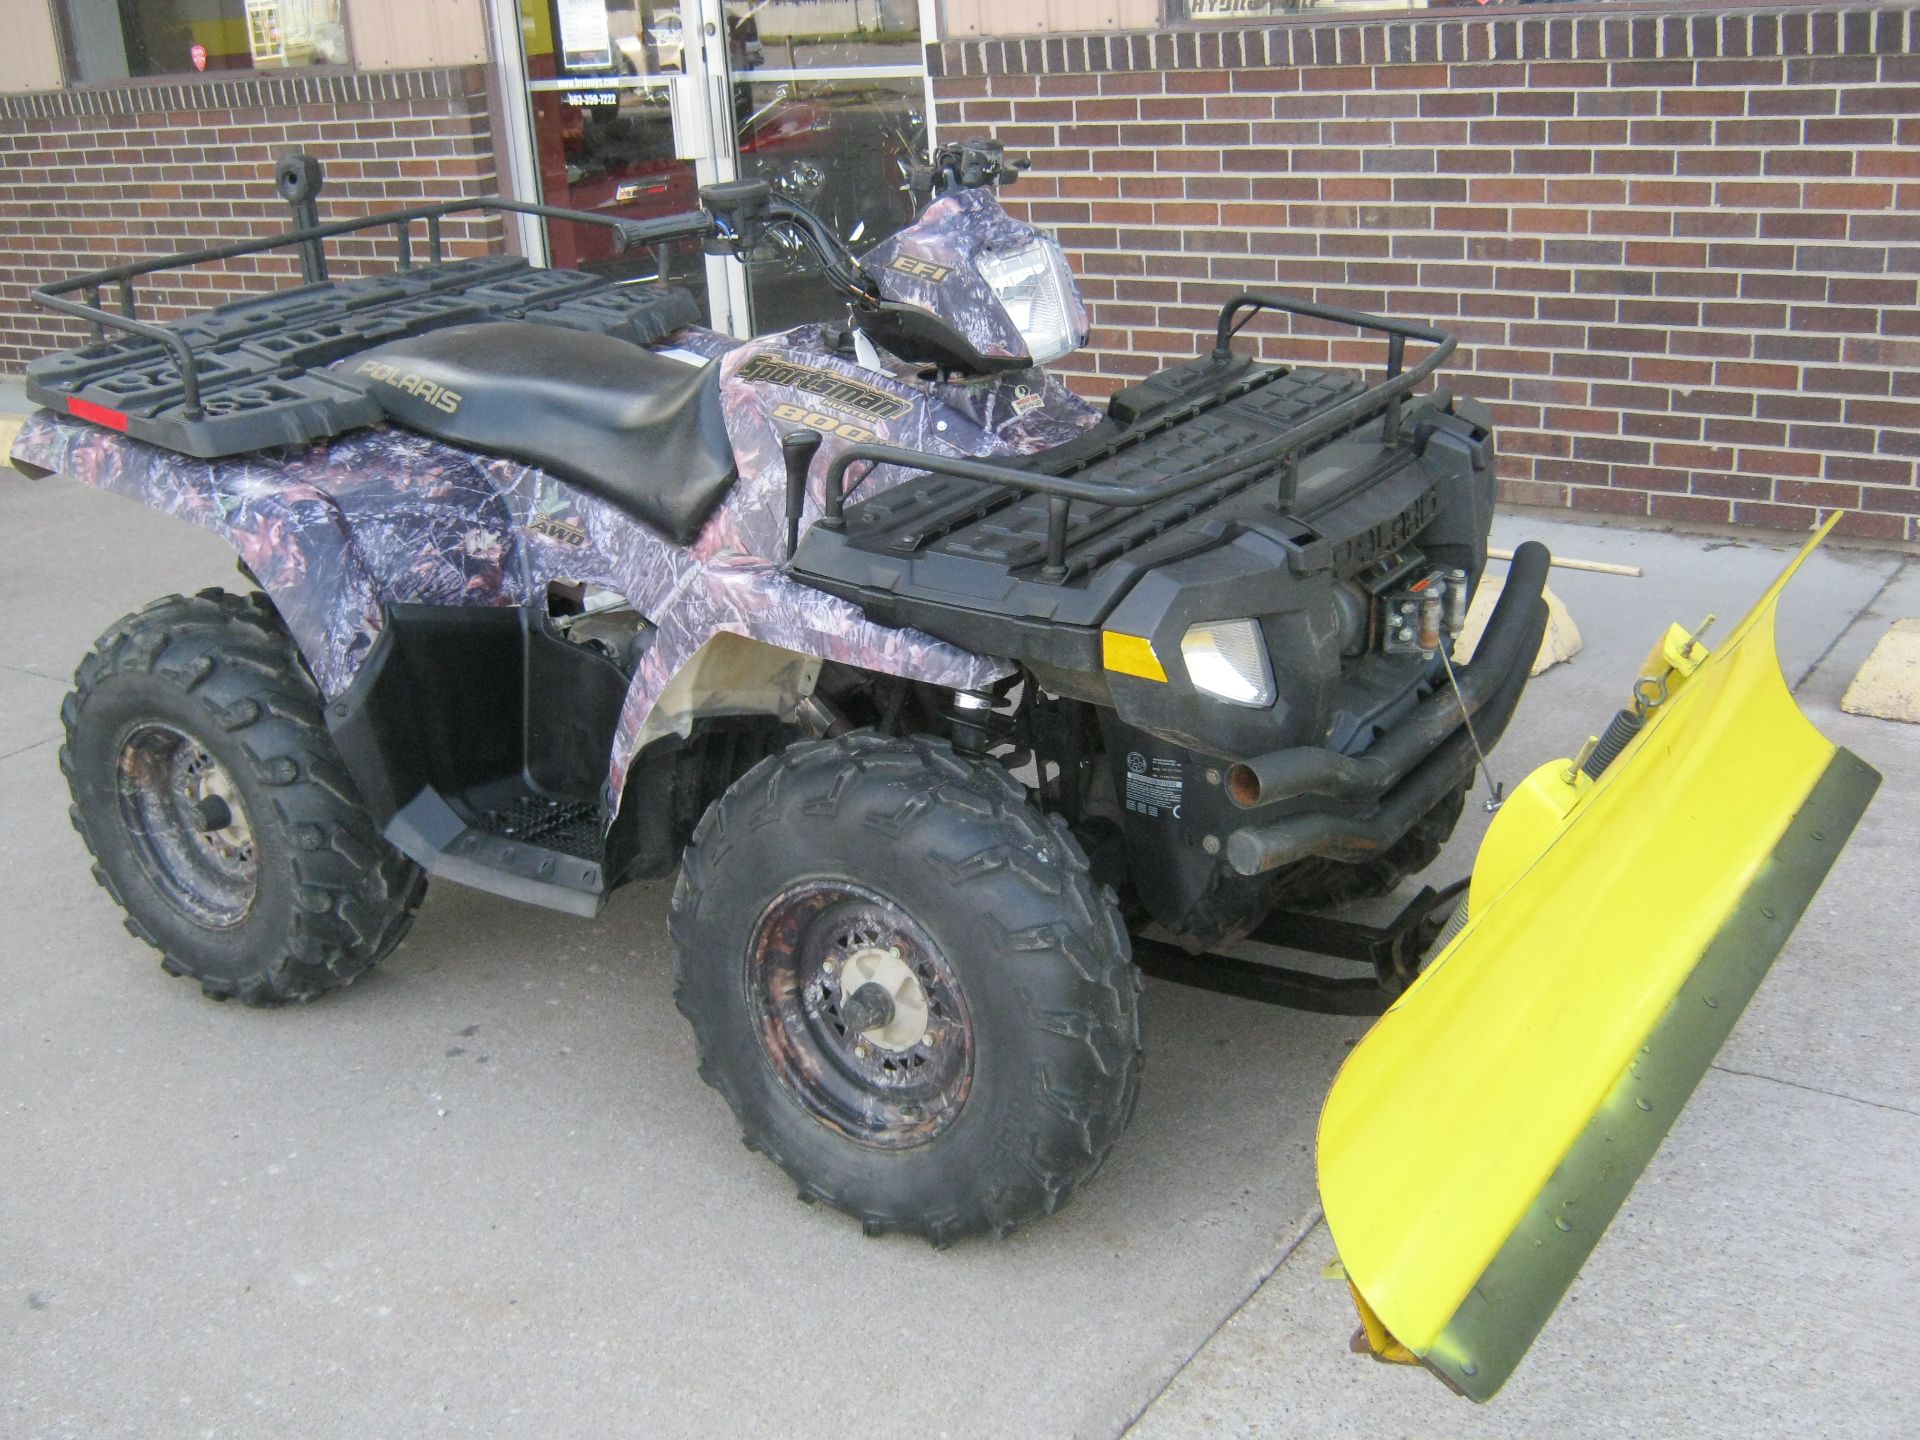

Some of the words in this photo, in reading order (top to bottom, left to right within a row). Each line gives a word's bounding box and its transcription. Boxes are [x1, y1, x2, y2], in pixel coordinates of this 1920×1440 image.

[892, 256, 947, 280] EFI
[355, 360, 463, 413] POLARIS
[738, 355, 904, 419] Sportsman
[772, 403, 875, 444] 800
[822, 399, 879, 424] HUNTER
[530, 521, 585, 547] AWD
